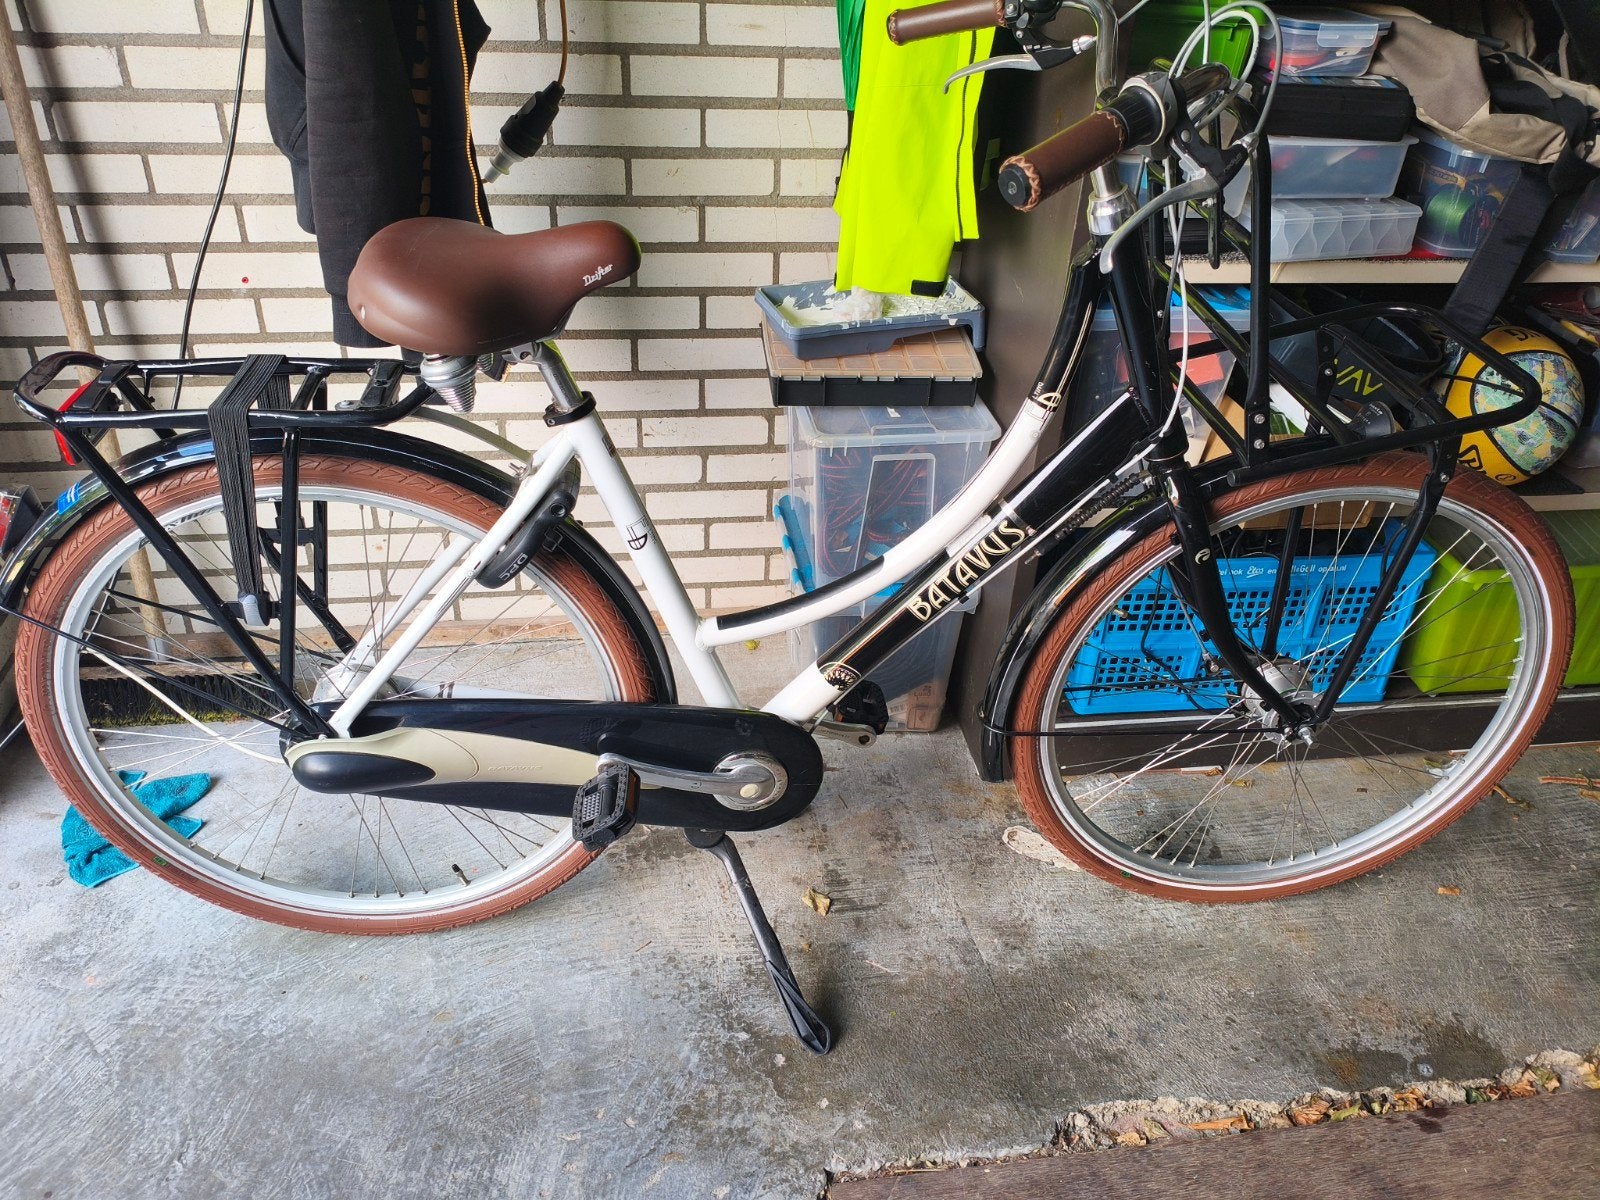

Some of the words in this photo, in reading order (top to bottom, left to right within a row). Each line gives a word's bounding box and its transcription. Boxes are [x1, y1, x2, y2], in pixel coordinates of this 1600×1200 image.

[582, 264, 613, 287] Drifter
[499, 552, 529, 581] DPC
[906, 519, 1025, 622] BATAVUS
